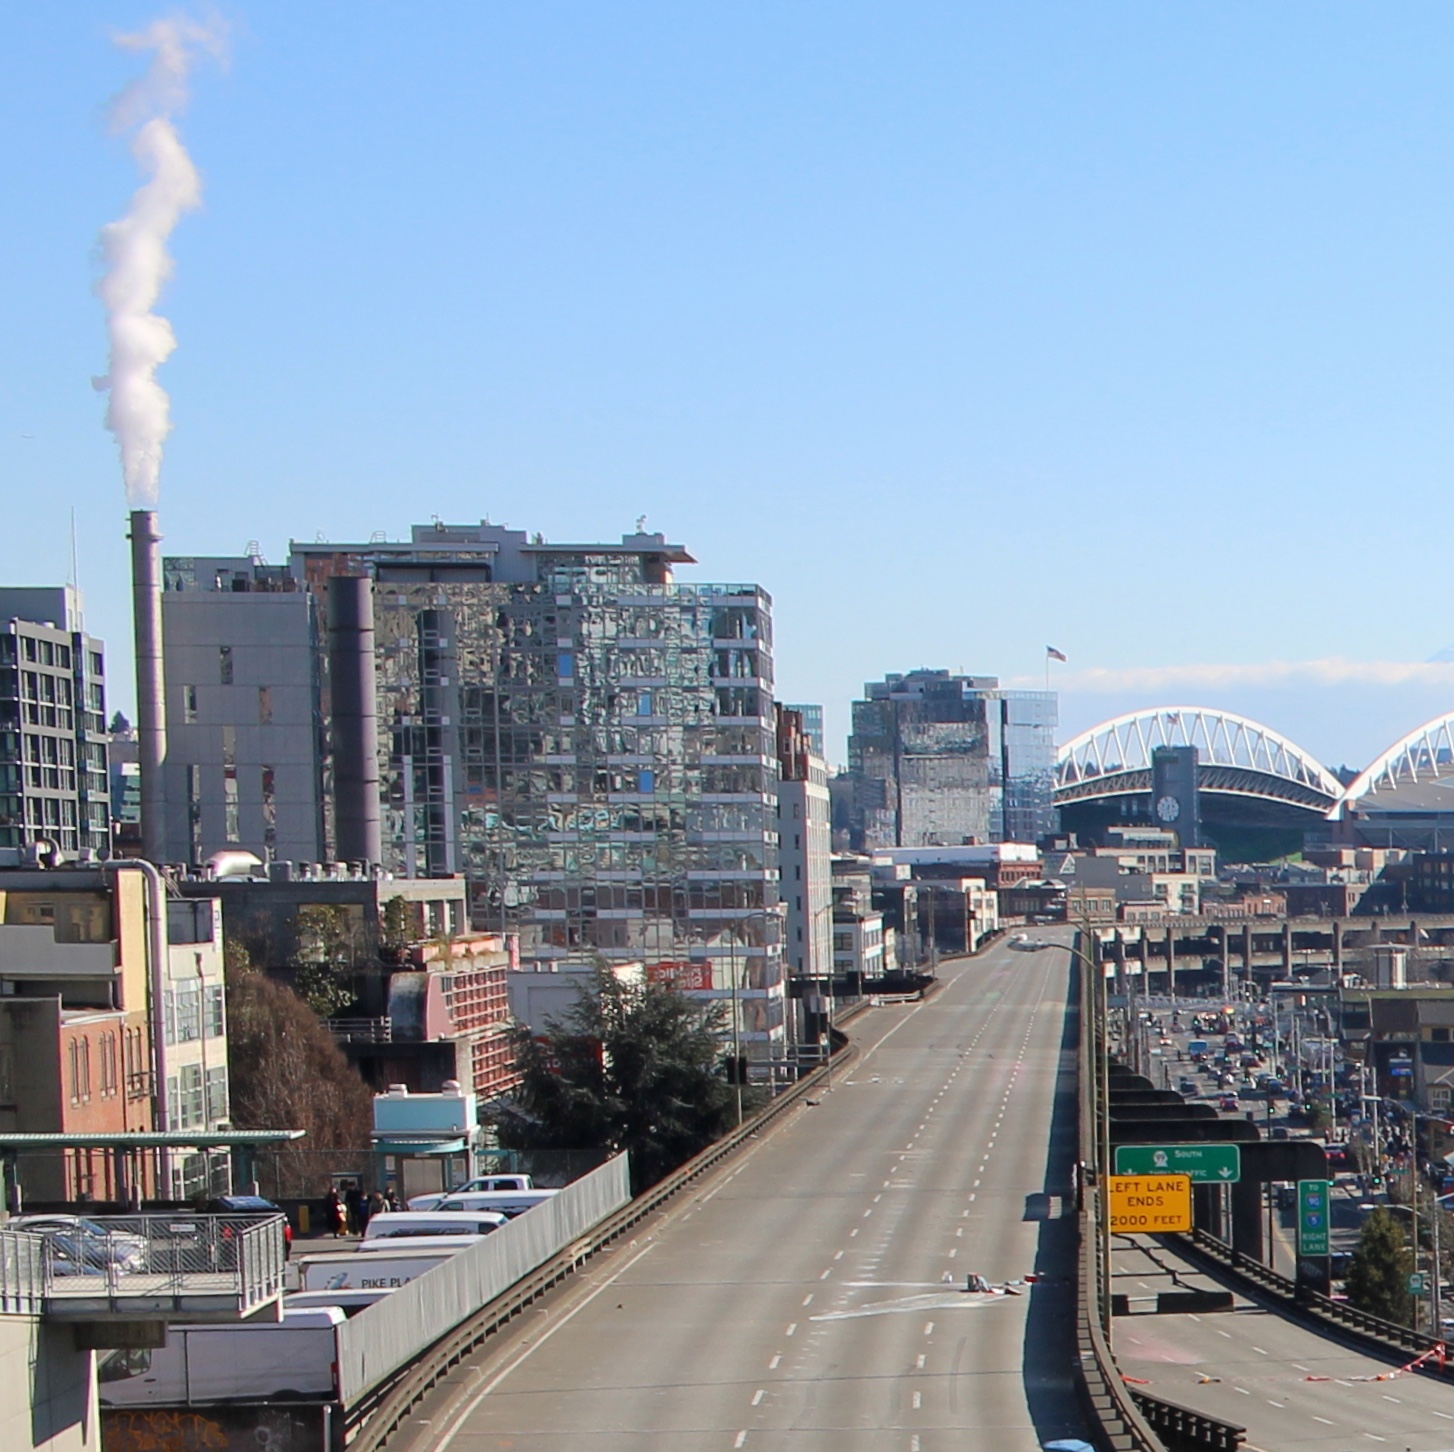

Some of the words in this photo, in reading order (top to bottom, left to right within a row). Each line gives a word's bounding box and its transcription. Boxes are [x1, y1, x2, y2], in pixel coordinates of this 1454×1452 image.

[1147, 1181, 1184, 1192] LANE
[1127, 1196, 1164, 1207] ENDS
[1110, 1215, 1148, 1226] 2000
[1154, 1215, 1183, 1225] FEET
[1302, 1232, 1327, 1241] RIGHT
[1303, 1243, 1327, 1252] LANE
[361, 1278, 386, 1289] PIKE
